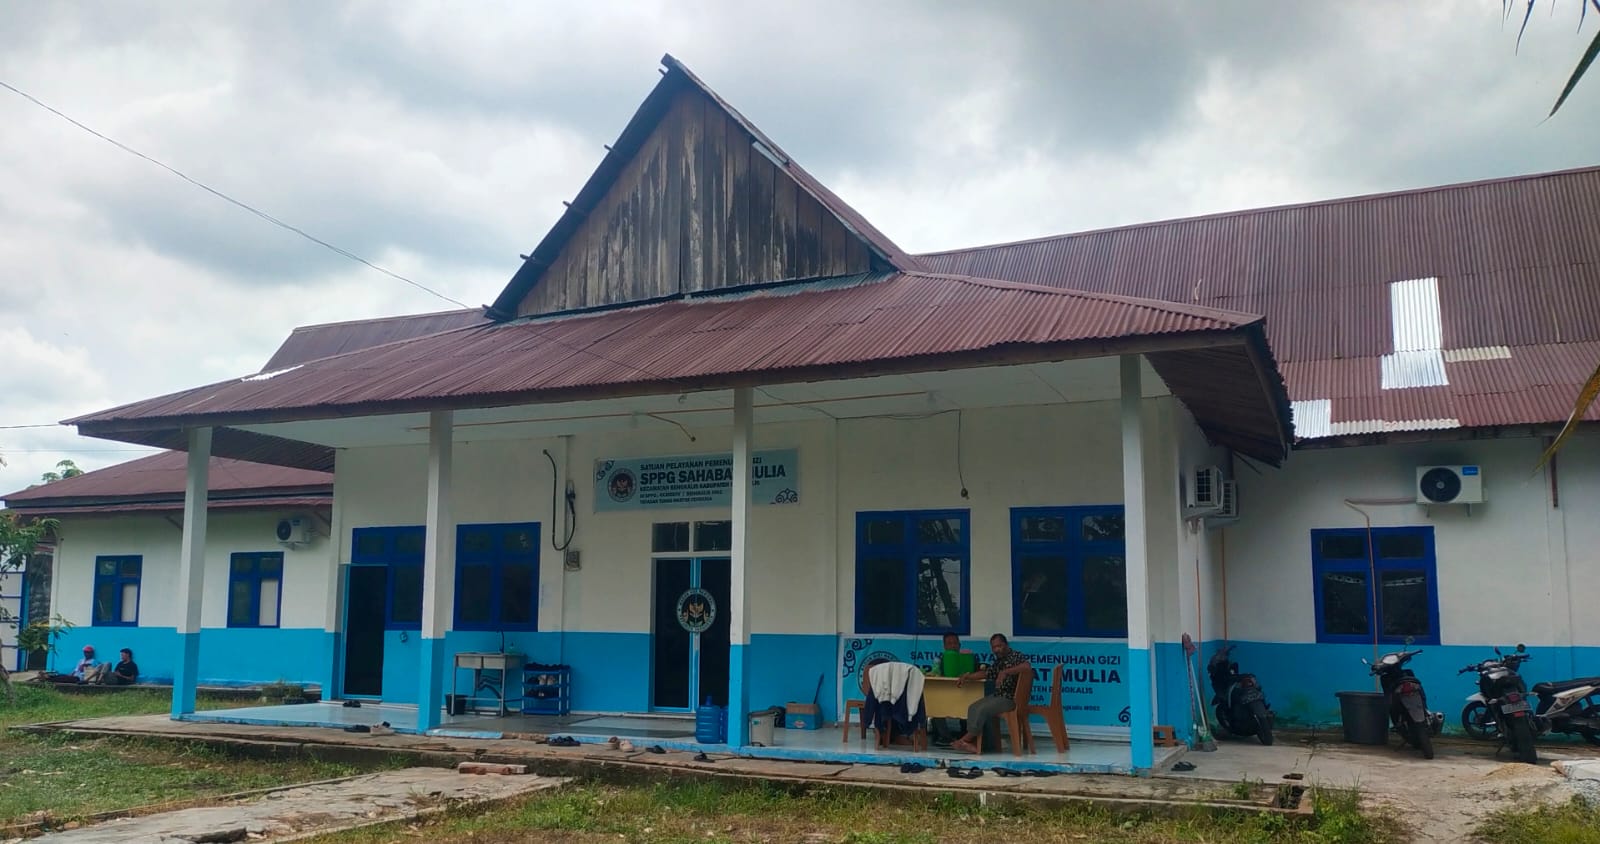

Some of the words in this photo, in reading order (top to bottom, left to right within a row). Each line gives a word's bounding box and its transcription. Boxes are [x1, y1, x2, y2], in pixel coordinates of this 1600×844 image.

[640, 463, 664, 471] SATUAN
[666, 461, 703, 469] PELAYANAN
[705, 459, 733, 467] PEMENU
[640, 471, 676, 485] SPPG
[678, 468, 734, 483] SAHABA
[752, 464, 786, 479] ULIA
[910, 651, 944, 660] SATU
[1023, 654, 1095, 664] PEMENUHAN
[1098, 655, 1121, 665] GIZI
[1061, 667, 1122, 683] MULIA
